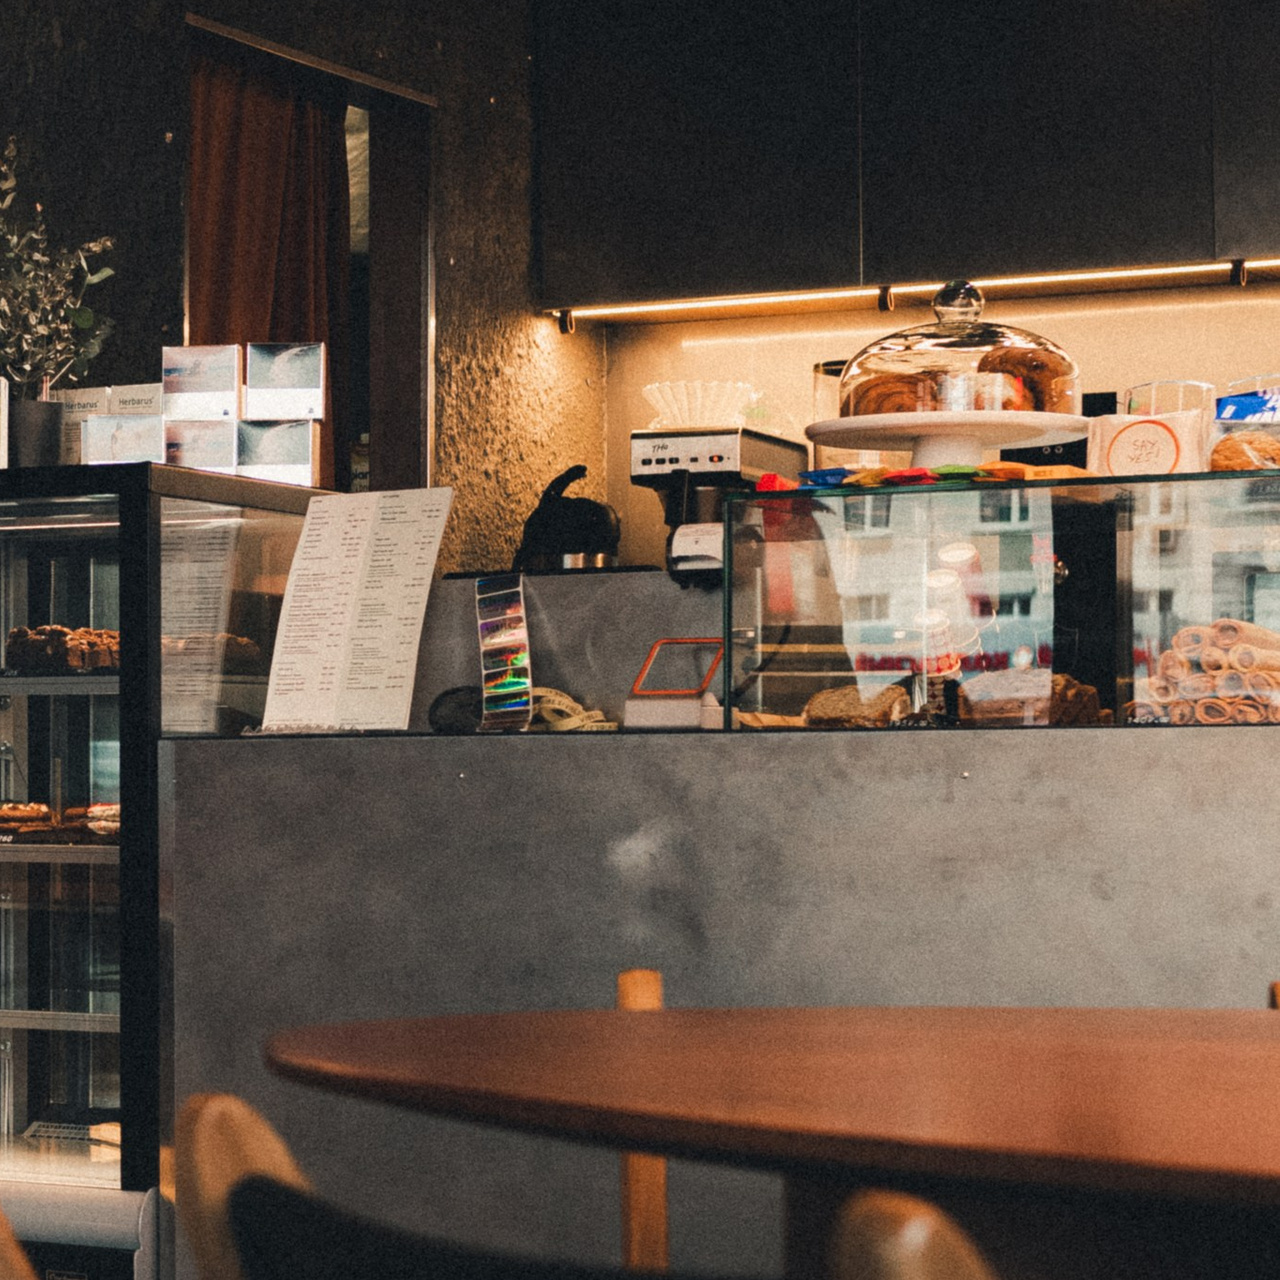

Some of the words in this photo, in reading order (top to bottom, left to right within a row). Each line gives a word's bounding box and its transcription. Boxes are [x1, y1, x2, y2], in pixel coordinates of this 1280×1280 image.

[65, 401, 99, 410] Herbarus
[119, 397, 154, 406] Herbarus
[1132, 439, 1158, 451] SAY
